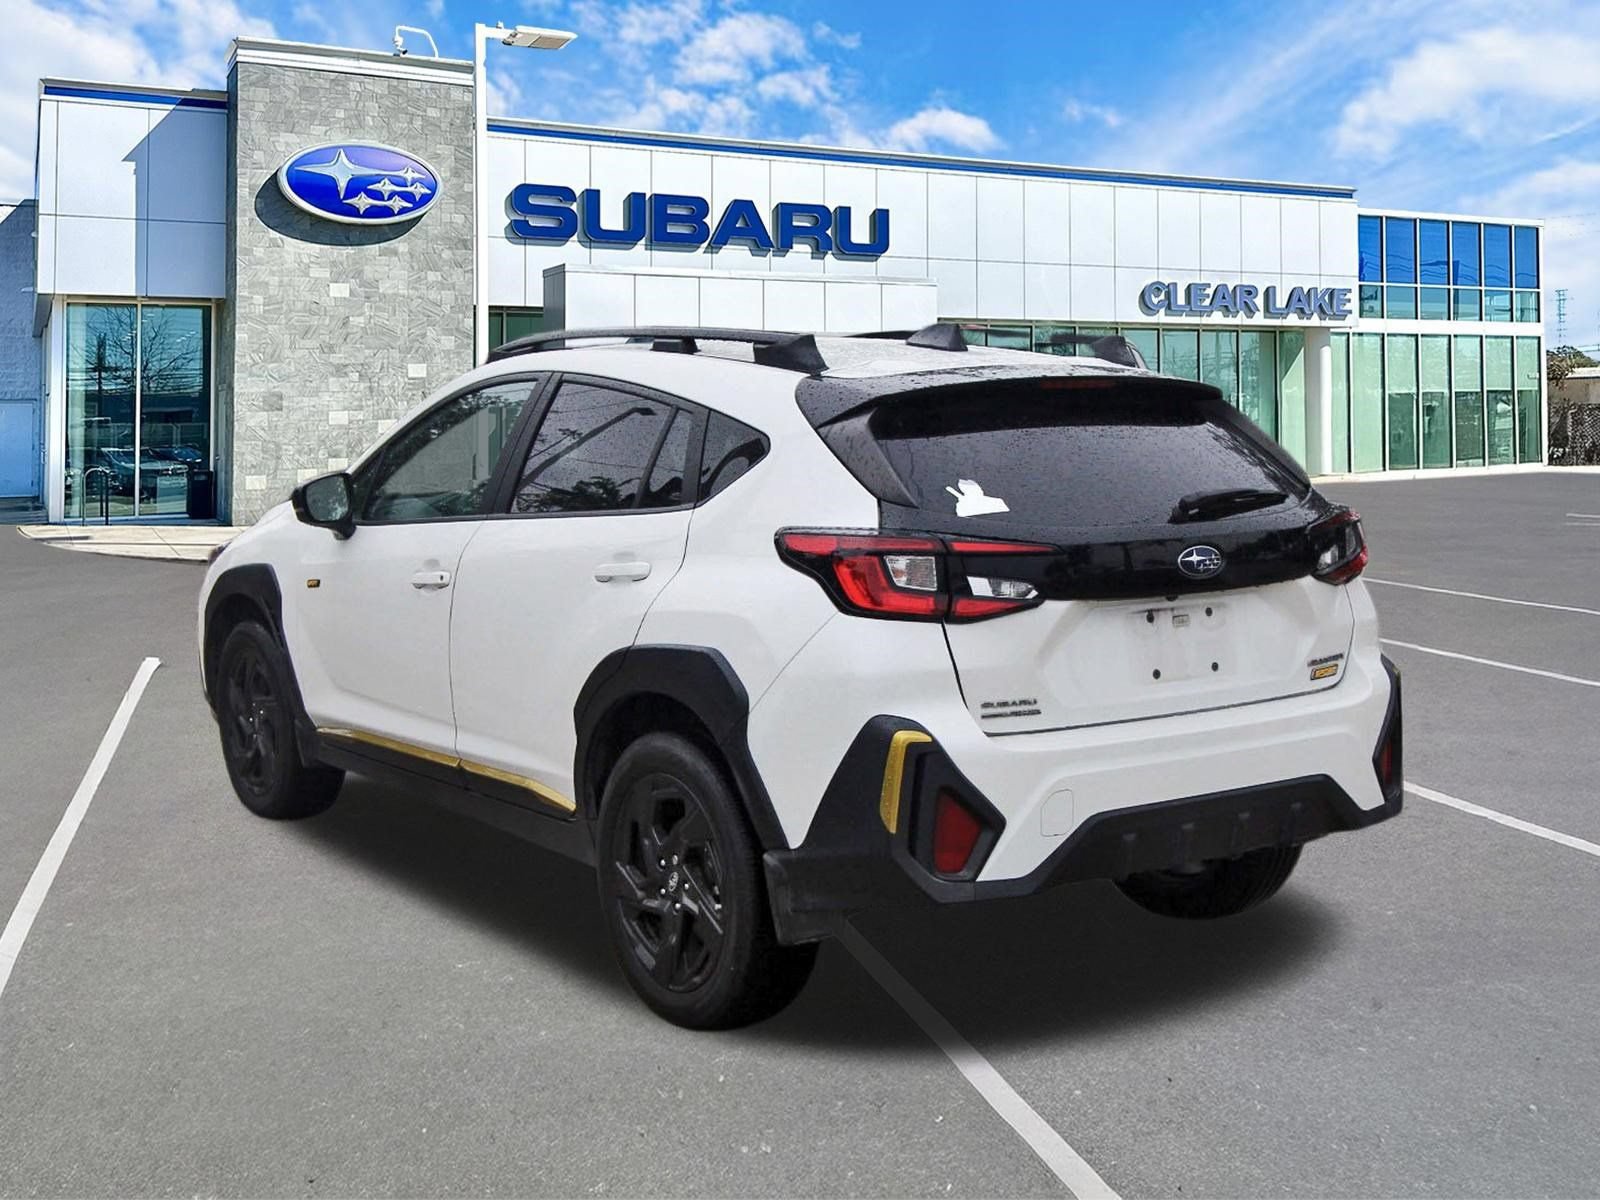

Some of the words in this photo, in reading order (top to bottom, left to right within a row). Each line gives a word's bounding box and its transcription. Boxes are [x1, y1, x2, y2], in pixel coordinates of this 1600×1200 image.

[506, 183, 889, 260] SUBARU
[1140, 281, 1259, 318] CLEAR
[1265, 286, 1353, 319] LAKE
